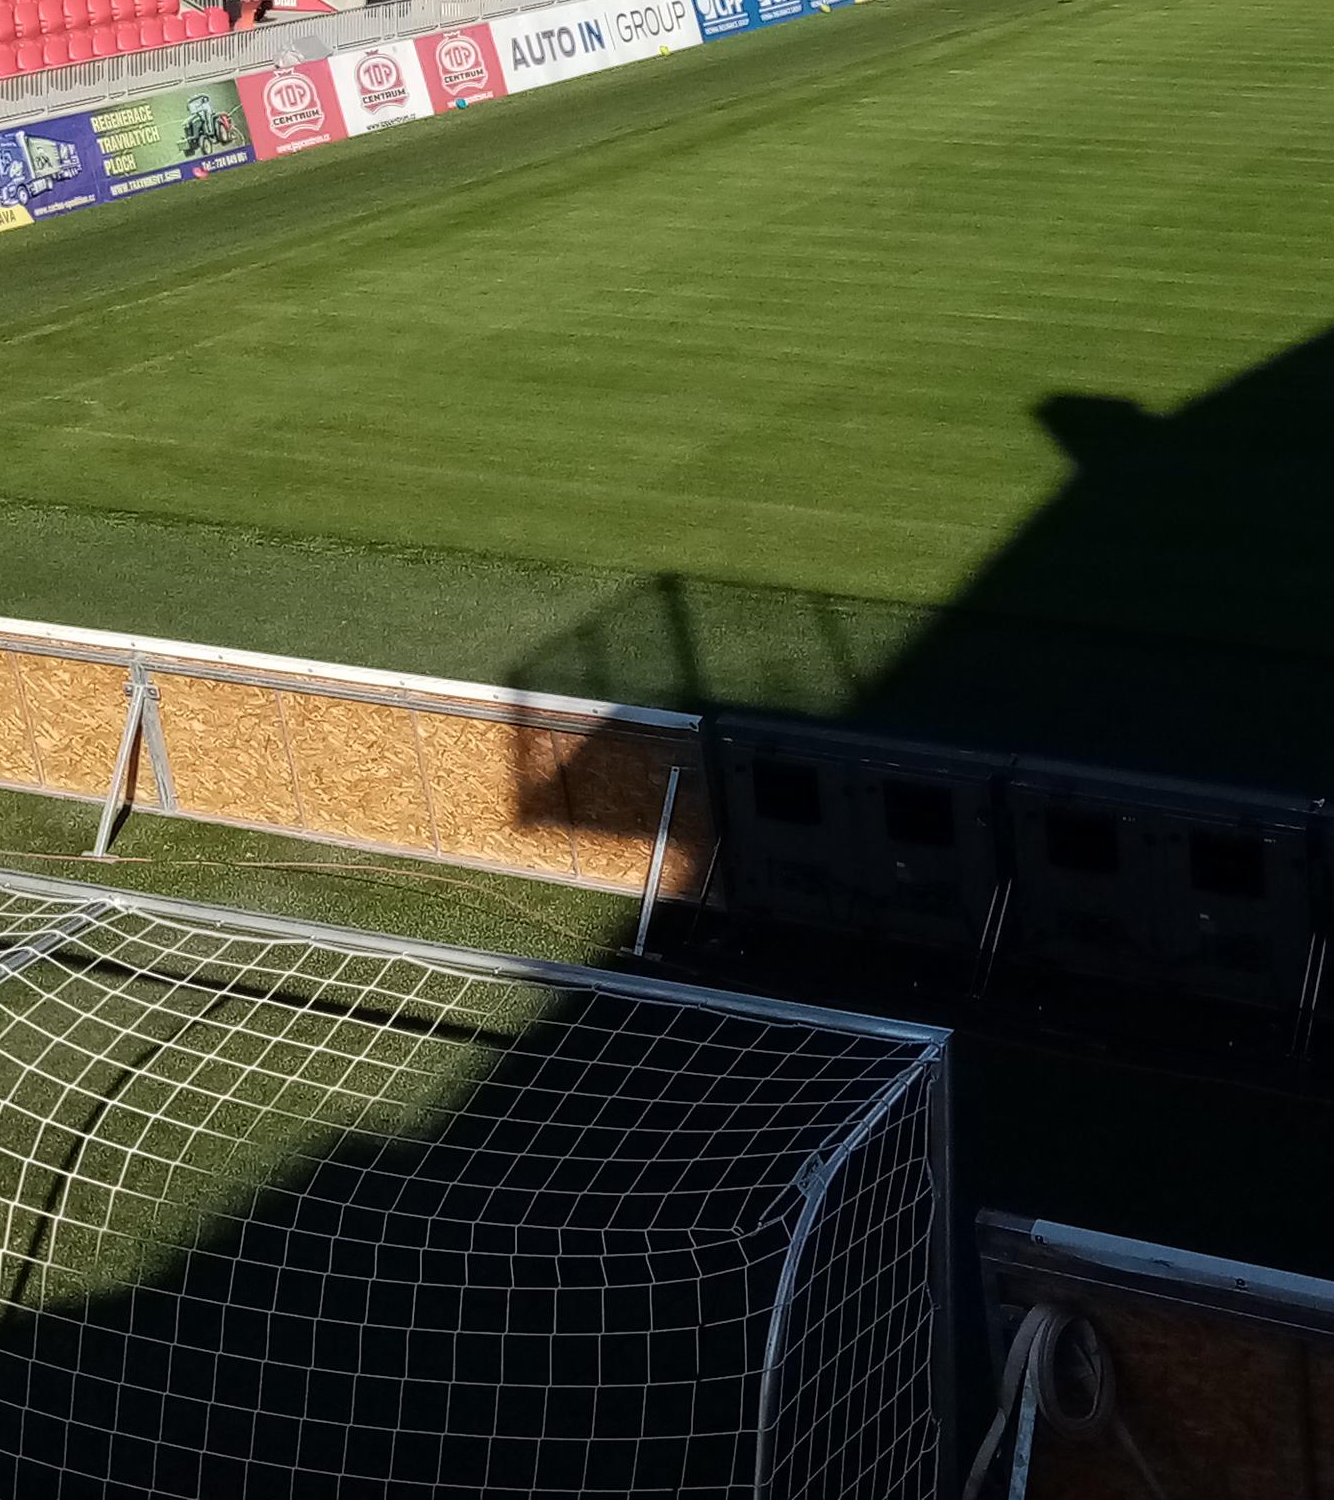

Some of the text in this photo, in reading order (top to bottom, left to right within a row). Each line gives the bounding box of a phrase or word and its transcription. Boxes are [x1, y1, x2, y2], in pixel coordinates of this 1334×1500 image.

[510, 0, 686, 71] AUTO IN GROUP
[445, 48, 473, 68] TOP
[364, 64, 394, 86] TOP
[444, 69, 485, 84] CENTRUM
[274, 85, 307, 109] TOP
[362, 88, 406, 105] CENTRUM
[90, 105, 154, 133] REGENERACE
[273, 109, 320, 126] CENTRUM
[97, 125, 160, 154] TRAVNATÝCH
[103, 153, 137, 176] PLOCH
